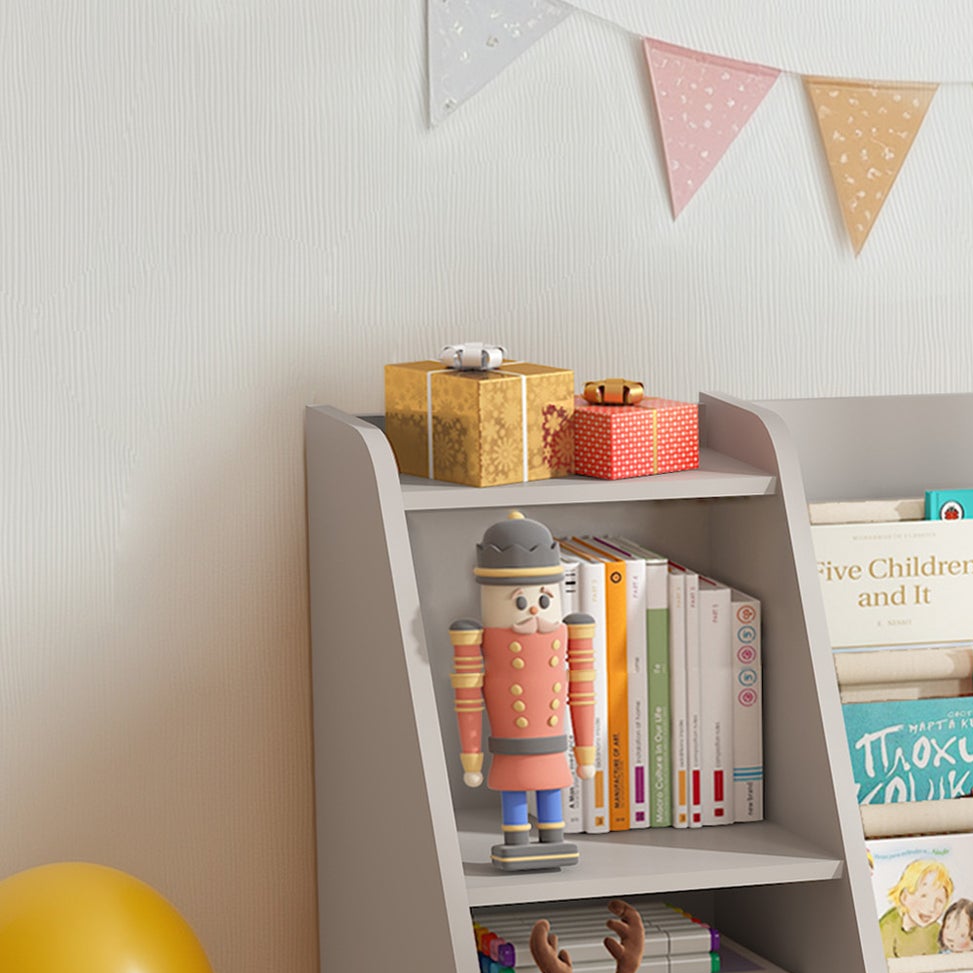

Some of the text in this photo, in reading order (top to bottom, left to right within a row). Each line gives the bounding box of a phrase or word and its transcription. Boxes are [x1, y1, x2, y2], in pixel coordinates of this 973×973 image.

[857, 585, 931, 608] and It
[655, 758, 663, 790] Culture
[655, 792, 663, 822] Macro
